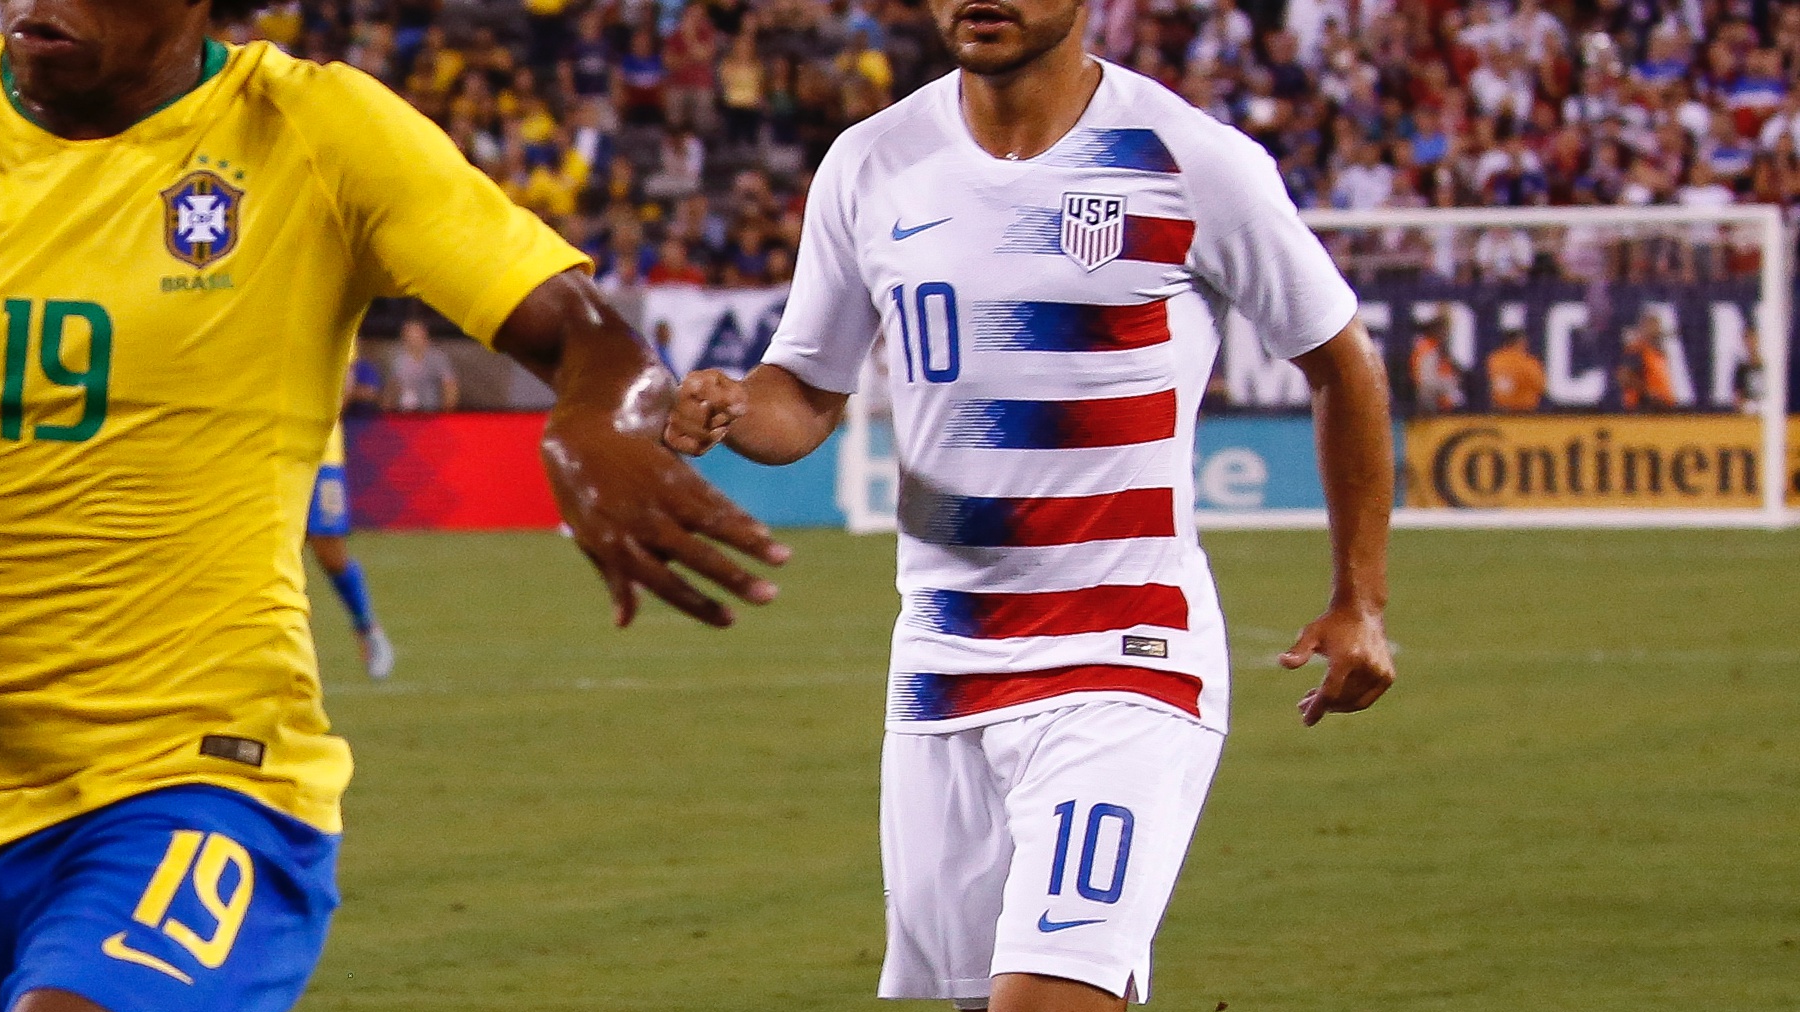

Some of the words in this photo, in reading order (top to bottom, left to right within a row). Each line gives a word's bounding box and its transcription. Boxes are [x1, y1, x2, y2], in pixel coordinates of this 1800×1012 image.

[1068, 197, 1121, 226] USA
[1, 298, 113, 442] 19
[892, 281, 960, 384] 10
[1432, 426, 1800, 510] Continen
[131, 829, 255, 969] 19
[1047, 798, 1136, 905] 10
